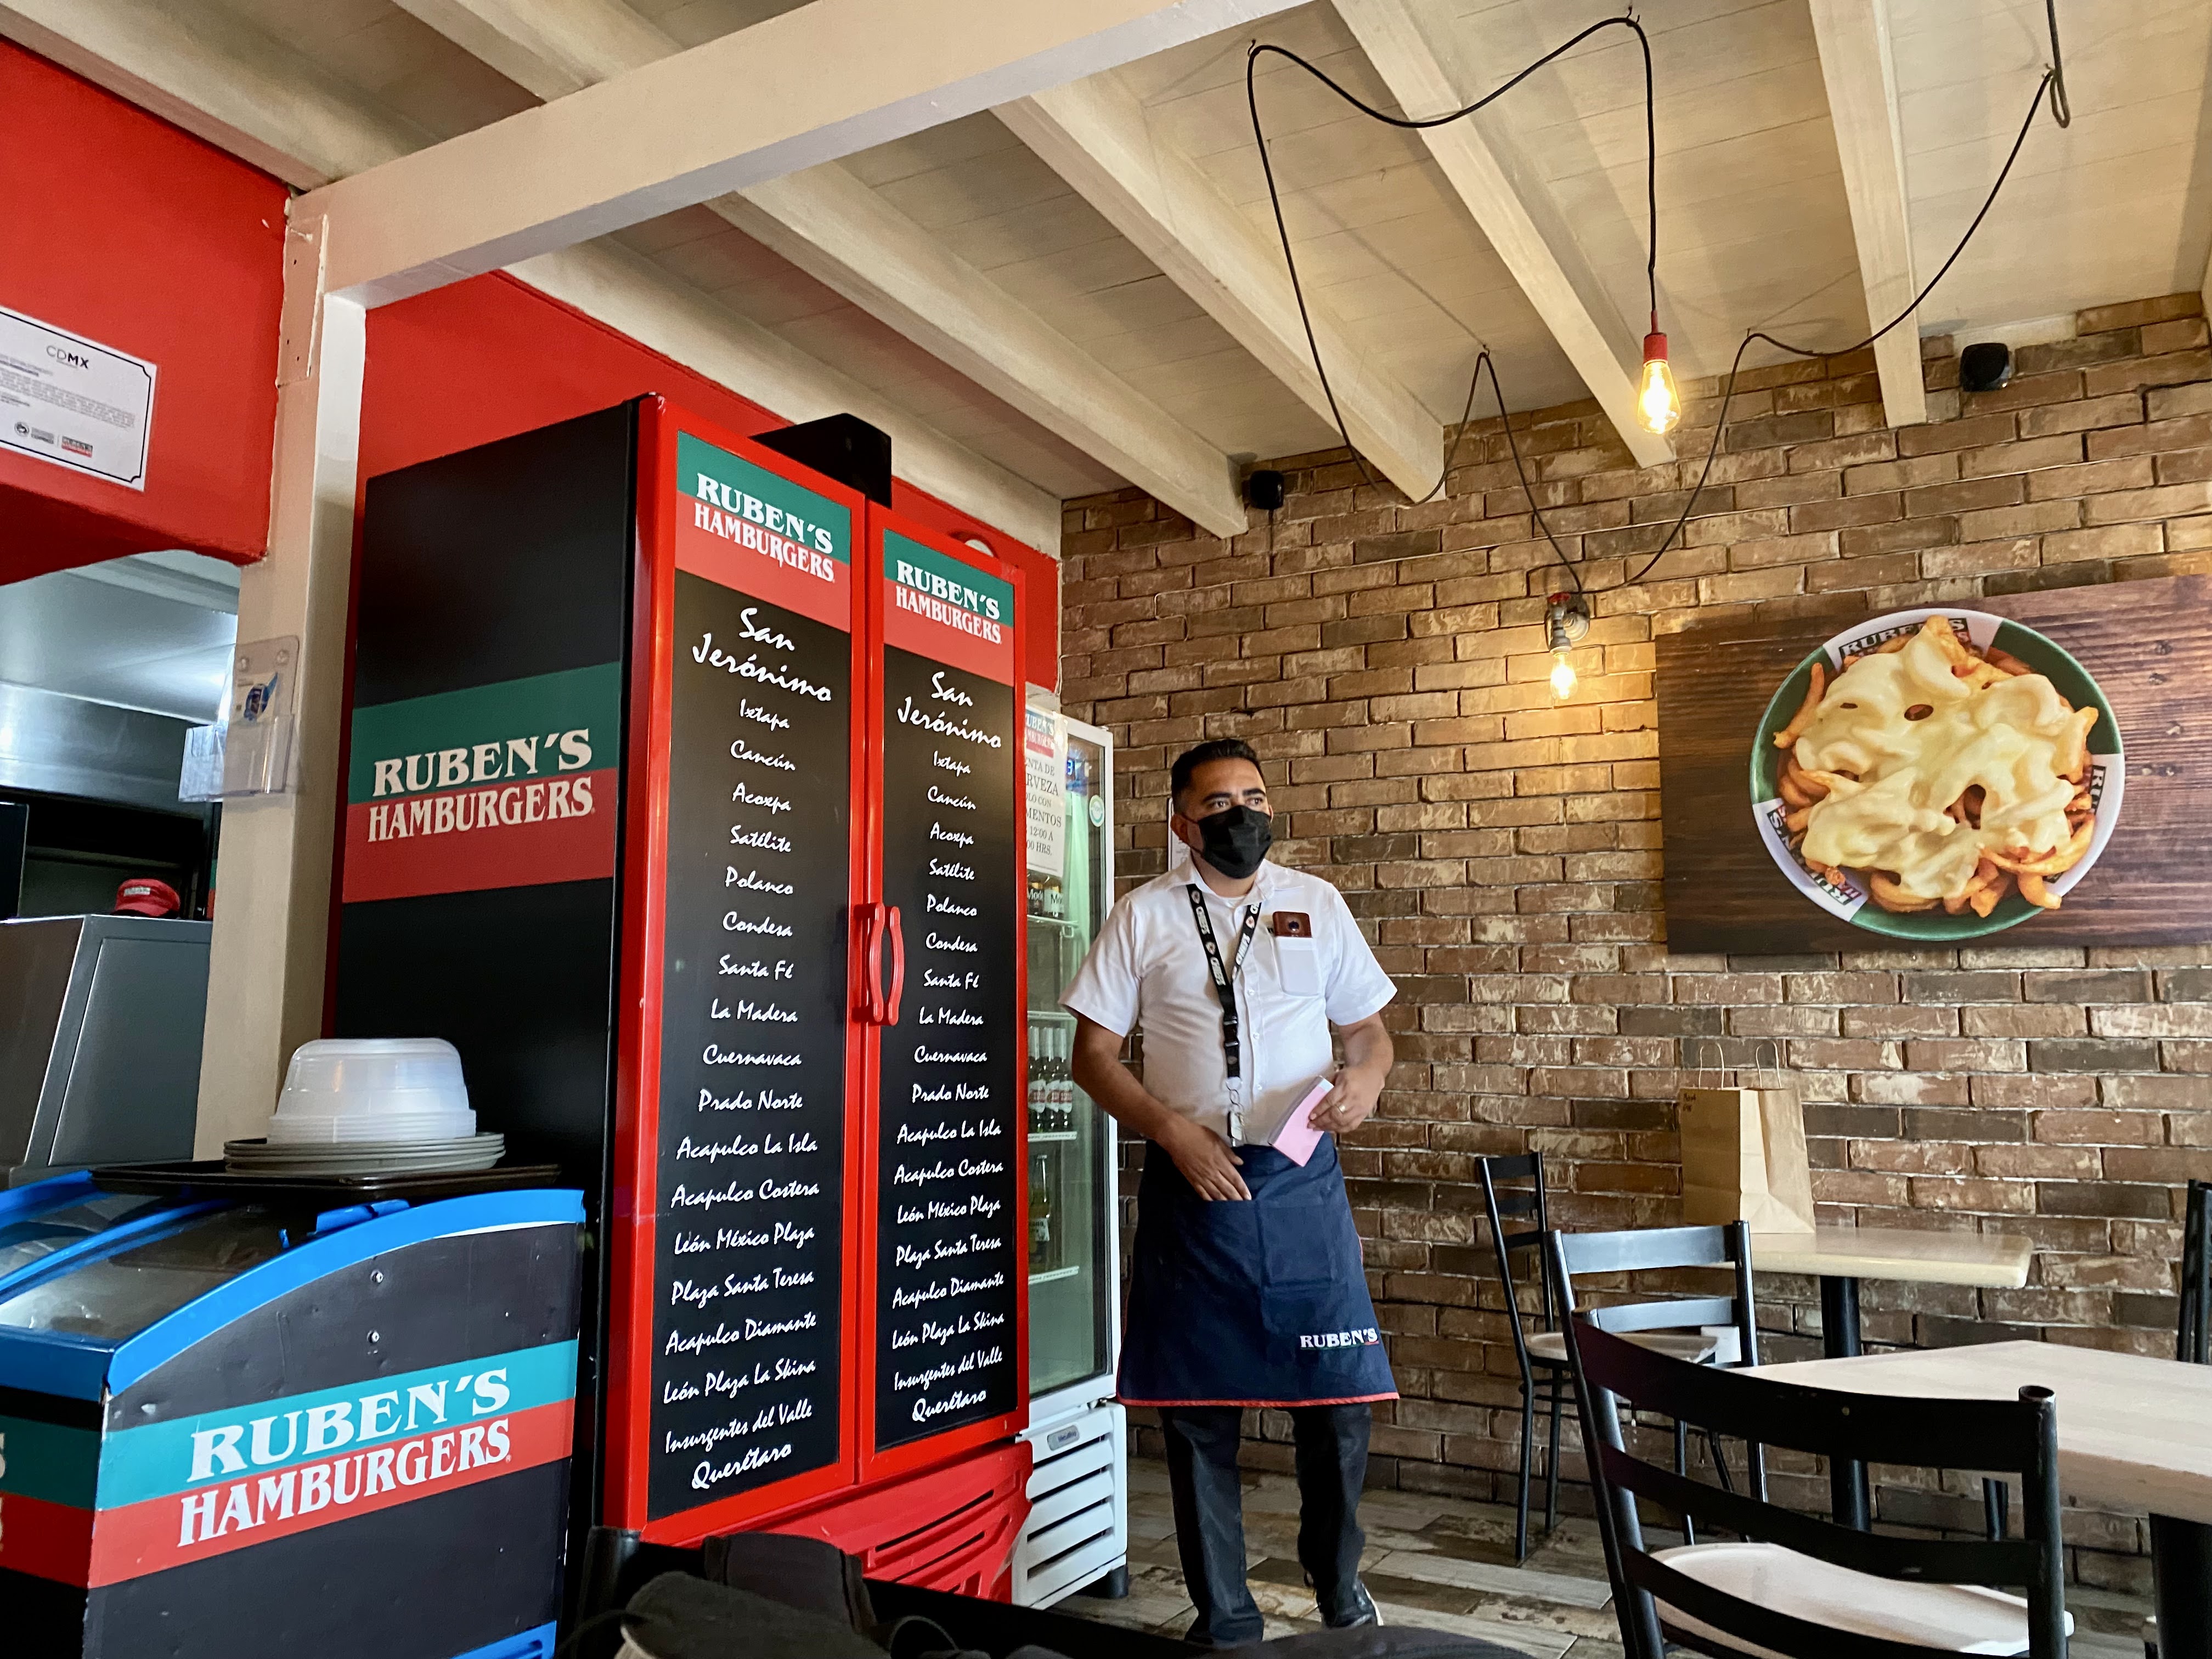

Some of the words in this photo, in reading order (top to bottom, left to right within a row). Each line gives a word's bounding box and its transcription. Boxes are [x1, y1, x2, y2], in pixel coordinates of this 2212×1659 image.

[46, 345, 89, 369] CDMX
[696, 473, 833, 555] RUBEN'S
[694, 503, 834, 582] HAMBURGERS
[896, 560, 1000, 620] RUBEN'S
[739, 607, 795, 651] San
[896, 585, 1001, 644] HAMBURGERS
[692, 633, 831, 701] Jerónimo
[931, 672, 973, 707] San
[740, 698, 790, 731] Ixtapa
[898, 696, 1001, 748] Jerónimo
[1026, 713, 1054, 736] UBEN'S
[372, 728, 592, 797] RUBEN'S
[730, 740, 795, 771] Cancún
[933, 751, 971, 777] Ixtapa
[1026, 757, 1043, 772] NTA
[1045, 764, 1054, 776] DE
[732, 782, 791, 815] Acoxpa
[927, 786, 976, 810] Cancún
[1026, 772, 1058, 797] RVEZA
[368, 776, 595, 842] HAMBURGERS
[1038, 796, 1052, 808] CON
[1026, 808, 1062, 827] MENTOS
[730, 825, 791, 853] Satélite
[930, 822, 974, 848] Acoxpa
[1048, 831, 1053, 842] A
[725, 866, 793, 895] Polanco
[929, 858, 975, 880] Satélite
[927, 894, 977, 916] Polanco
[723, 911, 793, 936] Condesa
[926, 932, 978, 952] Condesa
[718, 954, 769, 977] Santa
[775, 960, 794, 980] Fé
[923, 968, 961, 988] Santa
[965, 972, 979, 990] Fé
[710, 998, 731, 1019] La
[737, 1000, 798, 1023] Madera
[919, 1006, 934, 1024] La
[938, 1007, 984, 1025] Madera
[703, 1044, 802, 1066] Cuernavaca
[914, 1045, 988, 1063] Cuernavaca
[698, 1088, 752, 1112] Prado
[757, 1089, 803, 1110] Norte
[912, 1084, 952, 1103] Prado
[955, 1082, 989, 1101] Norte
[676, 1135, 758, 1164] Acapulco
[764, 1133, 783, 1154] La
[788, 1132, 818, 1153] Isla
[896, 1122, 957, 1147] Acapulco
[961, 1120, 975, 1138] La
[979, 1119, 1002, 1137] Isla
[894, 1161, 955, 1187] Acapulco
[958, 1159, 1003, 1177] Costera
[670, 1181, 754, 1211] Acapulco
[759, 1179, 820, 1200] Costera
[897, 1205, 924, 1224] León
[928, 1201, 967, 1220] México
[970, 1195, 1001, 1218] Plaza
[674, 1232, 711, 1255] León
[716, 1228, 769, 1250] México
[774, 1221, 815, 1249] Plaza
[896, 1244, 931, 1269] Plaza
[934, 1239, 968, 1260] Santa
[970, 1234, 1002, 1252] Teresa
[671, 1279, 719, 1309] Plaza
[724, 1273, 769, 1297] Santa
[772, 1267, 814, 1289] Teresa
[892, 1281, 947, 1309] Acapulco
[950, 1272, 1004, 1297] Diamante
[665, 1323, 740, 1356] Acapulco
[744, 1311, 816, 1341] Diamante
[892, 1330, 918, 1350] León
[922, 1321, 955, 1346] Plaza
[958, 1315, 971, 1334] La
[973, 1311, 1005, 1331] Skina
[1300, 1328, 1378, 1347] RUBEN'S
[663, 1381, 699, 1404] León
[704, 1370, 749, 1399] Plaza
[754, 1363, 770, 1385] La
[775, 1358, 816, 1381] Skina
[894, 1362, 956, 1391] Insurgentes
[958, 1352, 975, 1374] del
[977, 1346, 1002, 1368] Valle
[912, 1390, 986, 1422] Querétaro
[187, 1367, 511, 1482] RUBEN'S
[665, 1419, 748, 1453] Insurgentes
[752, 1406, 775, 1432] del
[778, 1398, 812, 1425] Valle
[691, 1444, 792, 1489] Querétaro
[177, 1418, 511, 1548] HAMBURGERS
